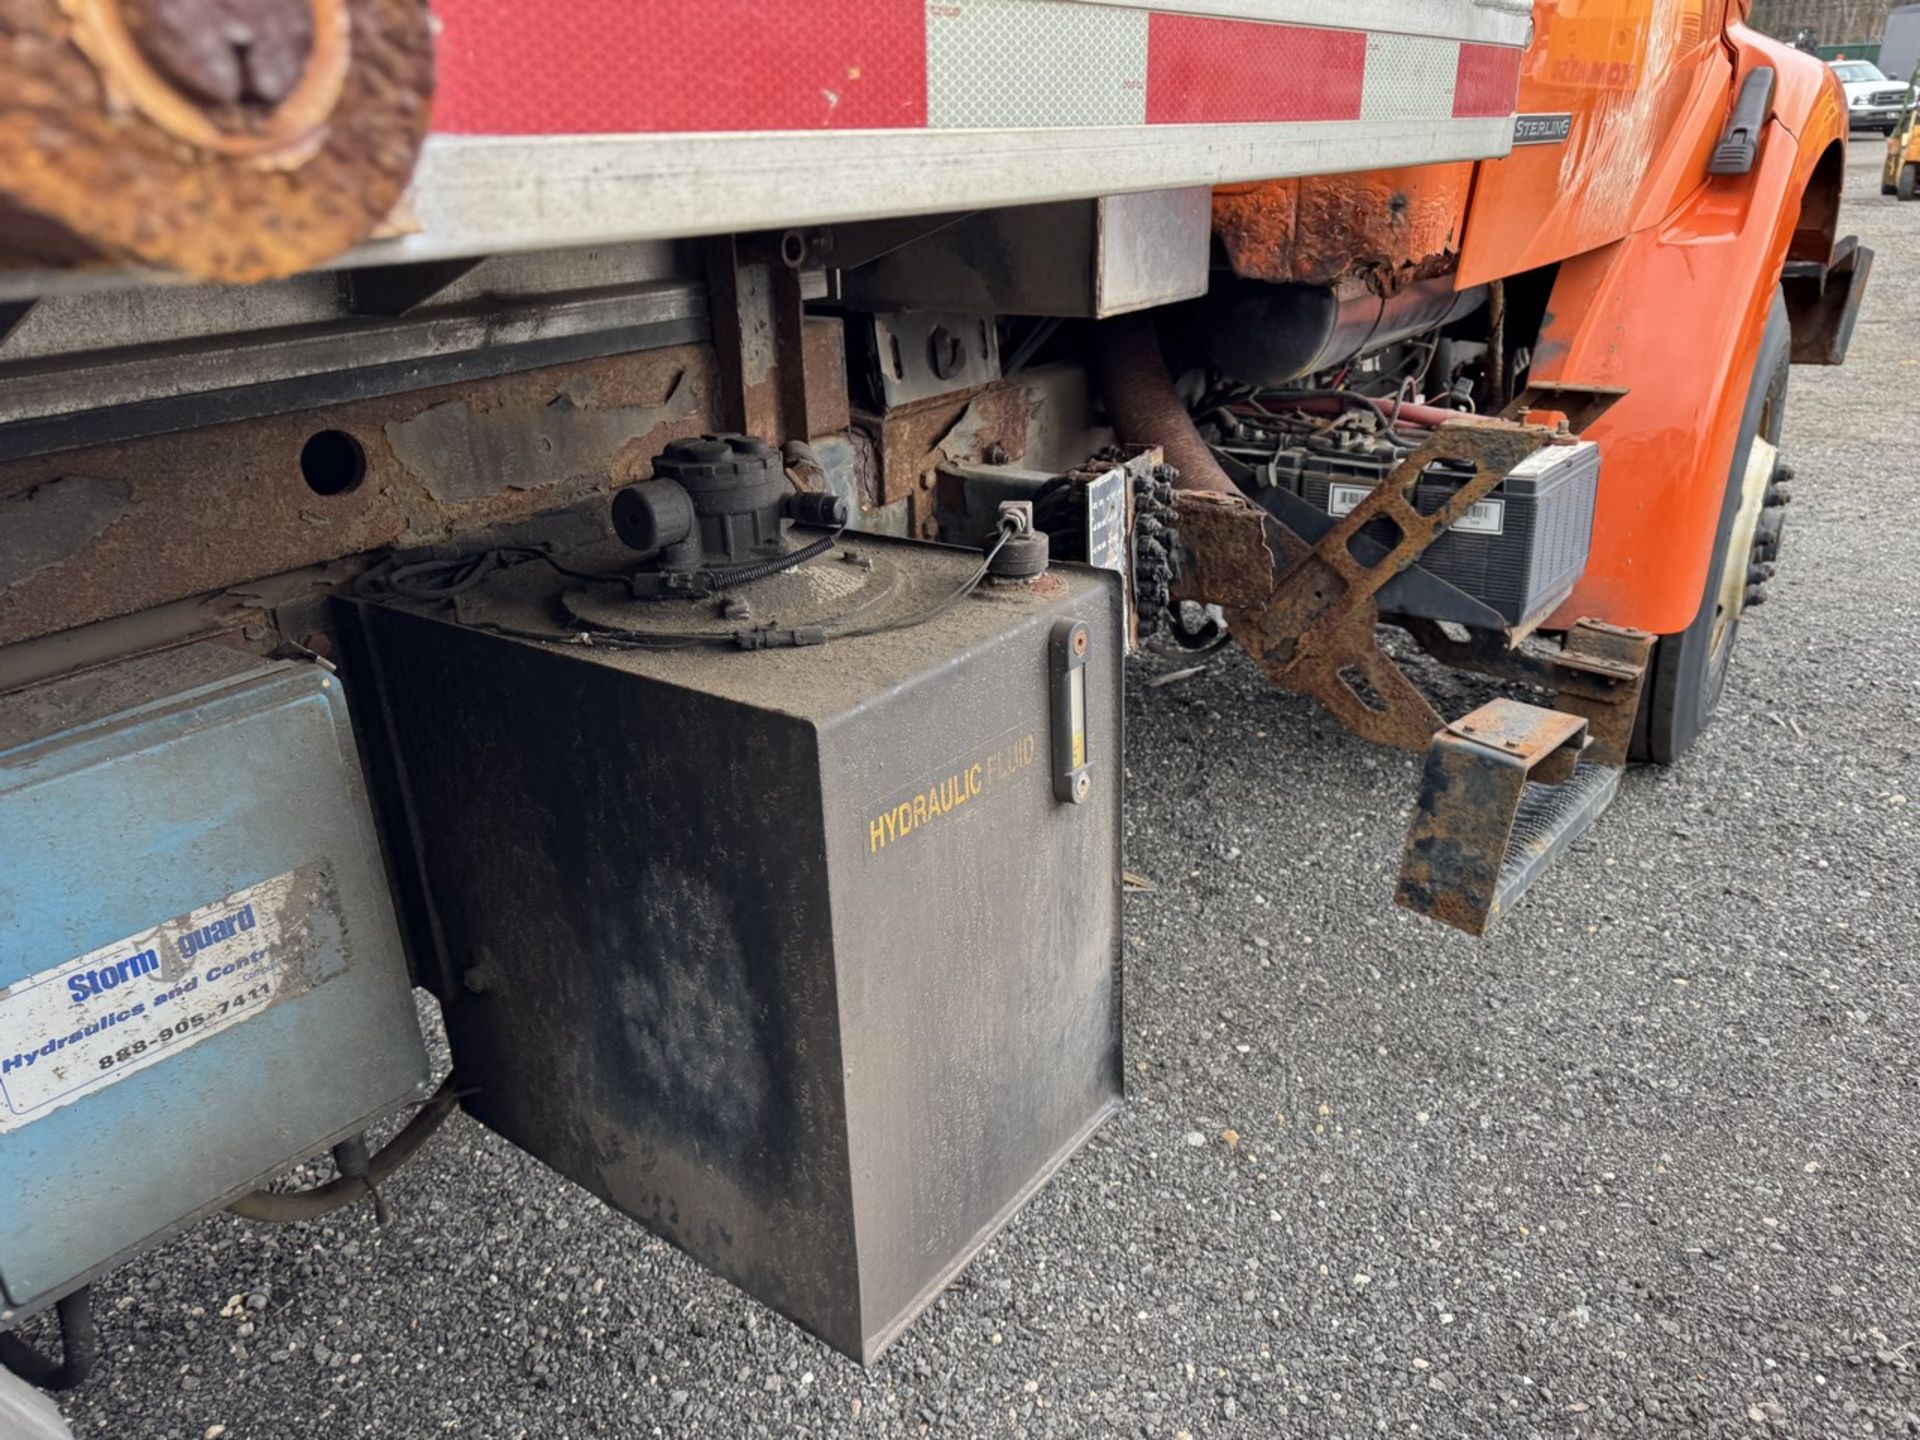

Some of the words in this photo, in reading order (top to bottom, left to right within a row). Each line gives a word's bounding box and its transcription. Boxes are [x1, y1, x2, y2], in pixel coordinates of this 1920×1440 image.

[1515, 119, 1569, 136] STERLING
[869, 763, 982, 853] HYDRAULIC
[986, 734, 1035, 781] FLUID
[67, 948, 159, 1003] Storm
[177, 903, 256, 960] guard
[1, 1005, 146, 1074] Hydraulics
[153, 977, 198, 1008] and
[206, 948, 270, 982] Contr
[98, 983, 271, 1070] 888-905-7411
